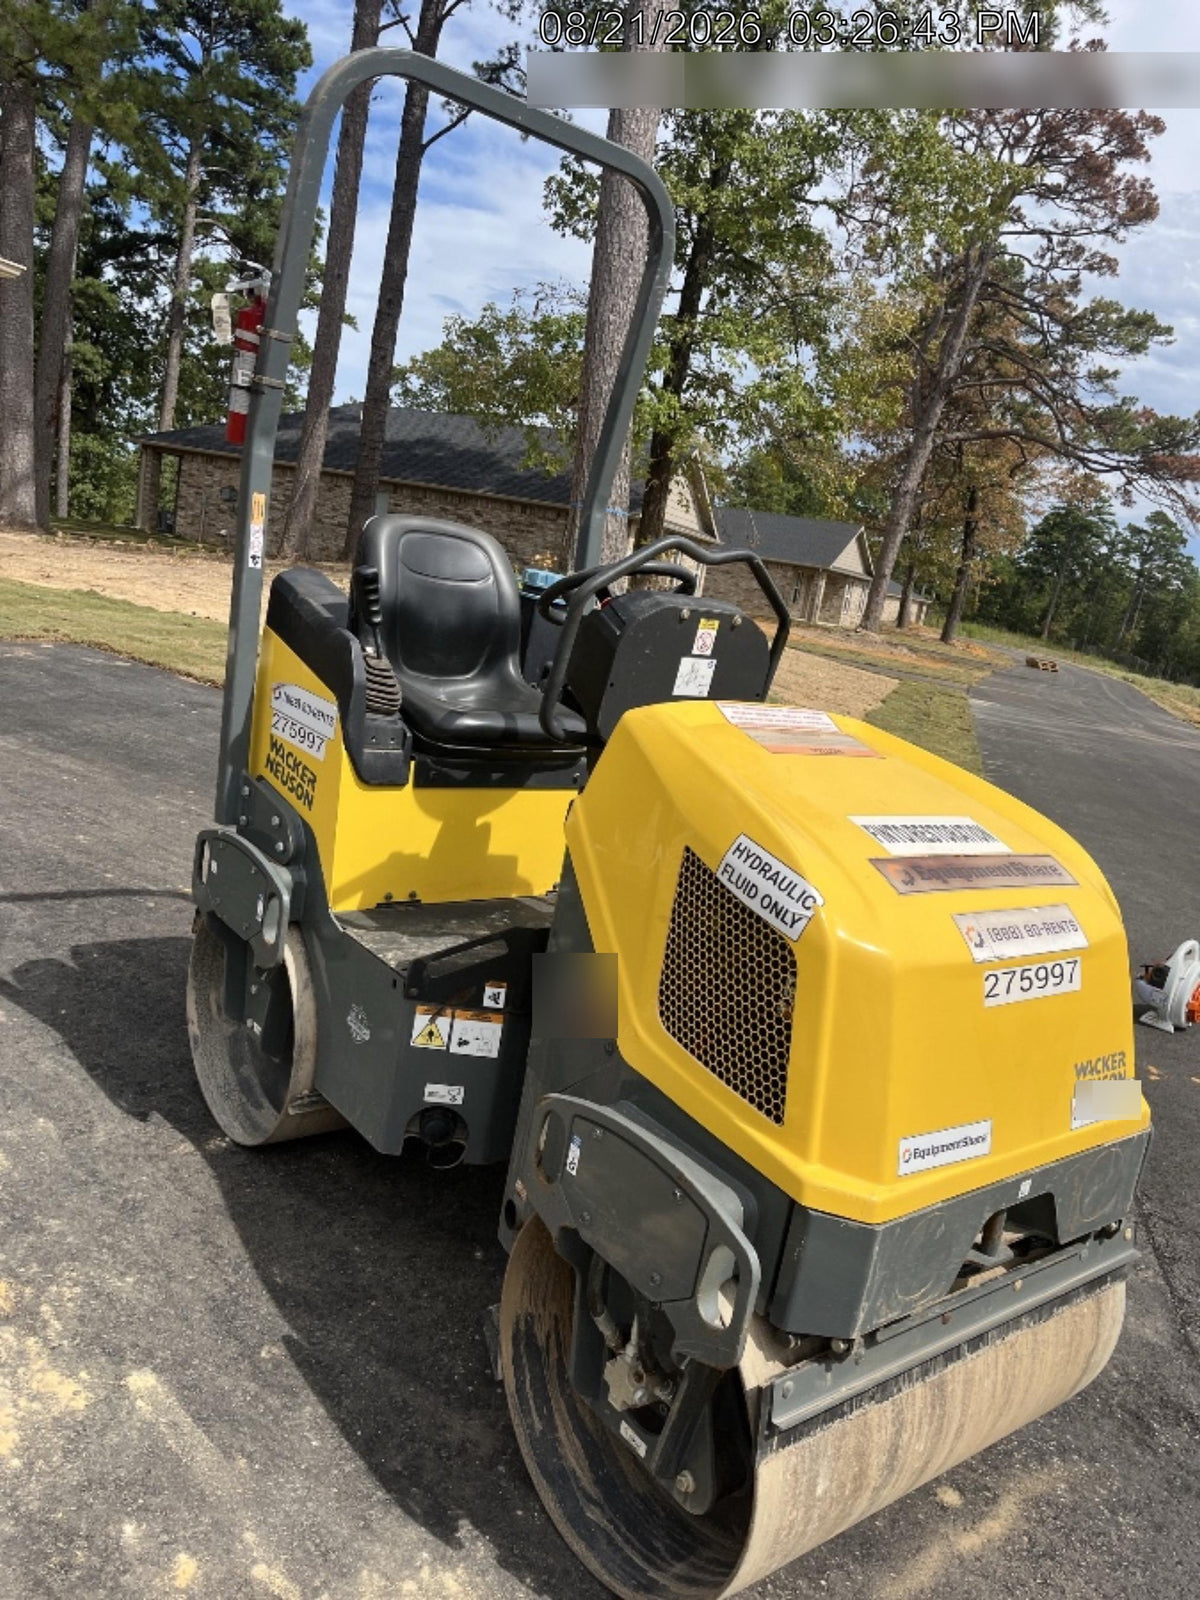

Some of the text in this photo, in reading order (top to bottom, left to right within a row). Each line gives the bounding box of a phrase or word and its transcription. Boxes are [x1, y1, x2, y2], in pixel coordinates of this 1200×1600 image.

[271, 712, 325, 752] 275997
[265, 753, 315, 811] NEUSON
[270, 735, 317, 792] WACKER
[732, 842, 817, 910] HYDRAULIC
[913, 861, 1062, 884] EquipmentShare
[721, 863, 804, 928] FLUID ONLY
[1024, 919, 1079, 938] 80-RENTS
[984, 960, 1078, 999] 275997
[1074, 1050, 1126, 1080] WACKER
[913, 1132, 988, 1164] EquipmentShare
